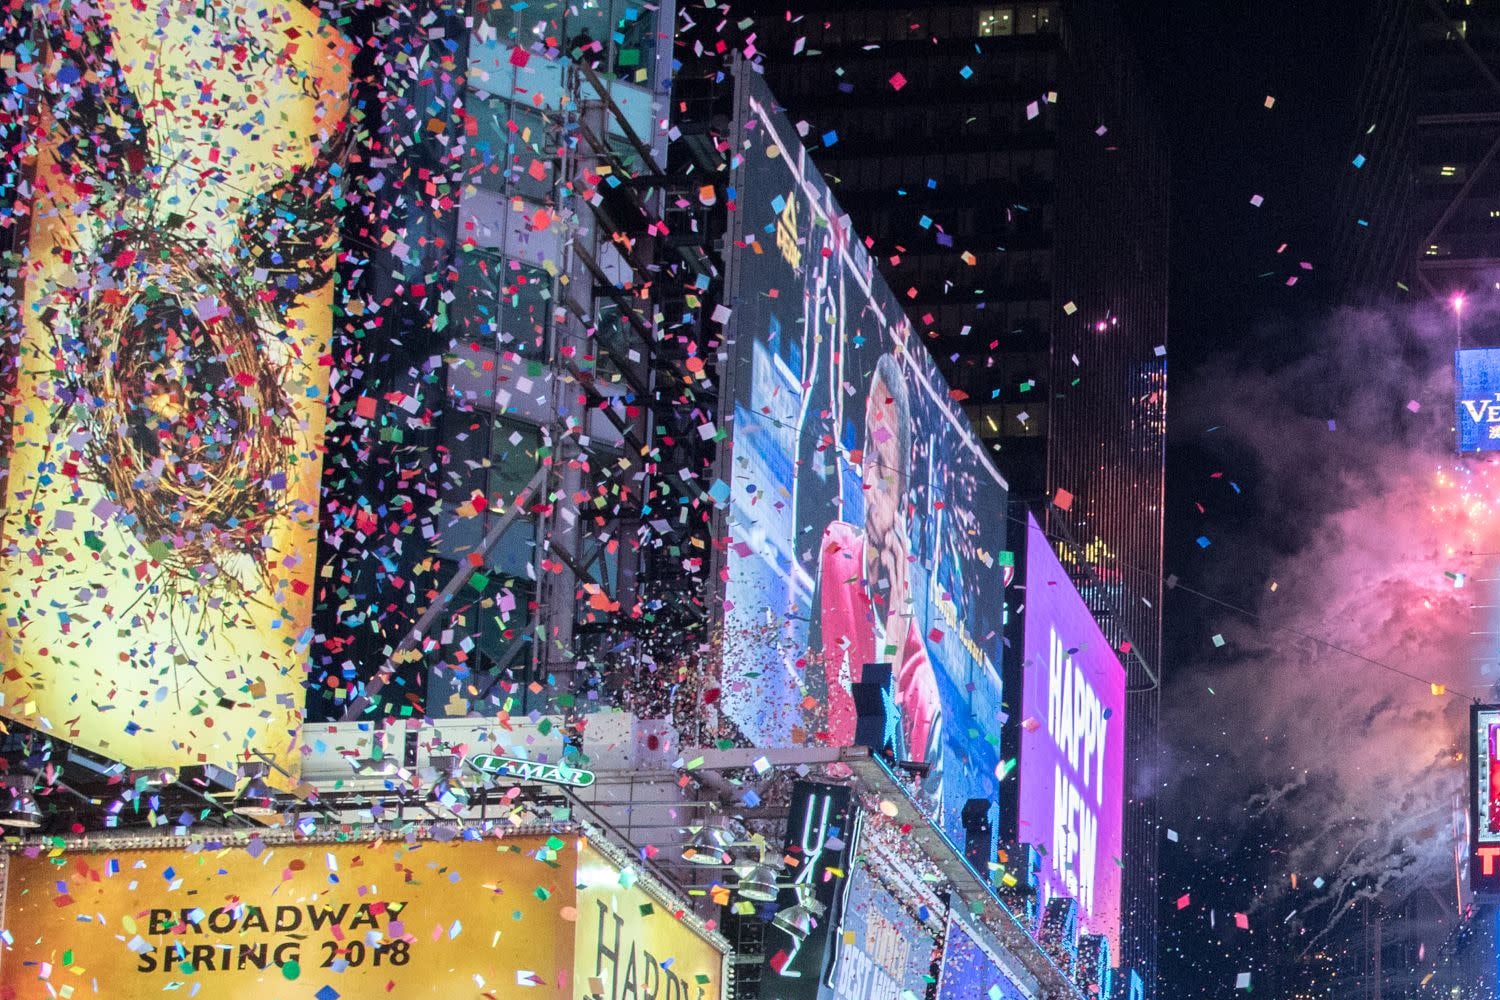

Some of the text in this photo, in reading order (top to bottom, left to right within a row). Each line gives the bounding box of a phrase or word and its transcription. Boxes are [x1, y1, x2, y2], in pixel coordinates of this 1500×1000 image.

[1047, 625, 1109, 808] HAPPY
[1052, 764, 1098, 920] NEW
[137, 938, 411, 974] SPRING 2018
[148, 901, 409, 936] BROADWAY
